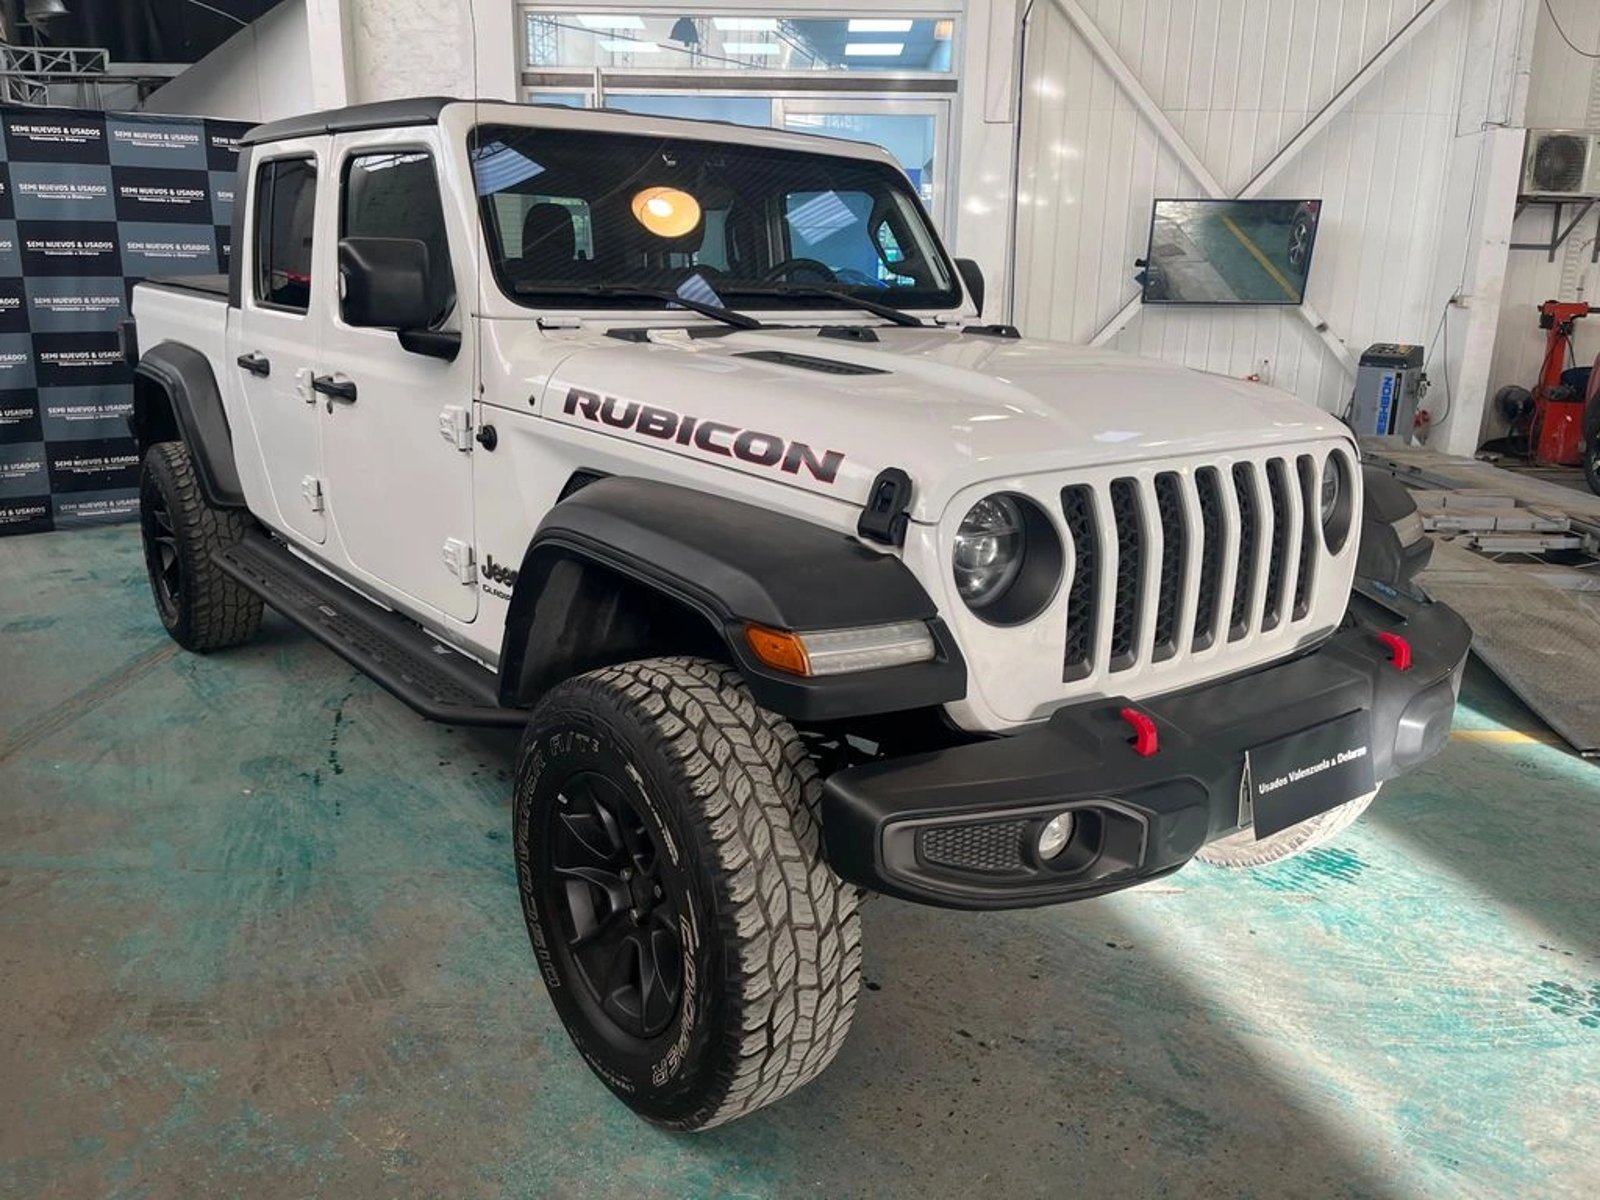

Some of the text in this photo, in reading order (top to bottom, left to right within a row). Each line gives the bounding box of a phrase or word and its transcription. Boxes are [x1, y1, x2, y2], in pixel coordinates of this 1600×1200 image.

[30, 126, 61, 134] NUEVOS
[70, 128, 101, 136] USADOS
[133, 131, 162, 140] NUEVOS
[170, 134, 199, 142] USADOS
[19, 183, 37, 191] SEMI
[77, 185, 107, 193] USADOS
[139, 187, 168, 195] NUEVOS
[176, 189, 204, 197] USADOS
[182, 243, 210, 251] USADOS
[40, 352, 58, 360] SEMI
[563, 387, 846, 484] RUBICON
[1259, 777, 1288, 794] Usados
[1289, 760, 1330, 782] Valenzuela
